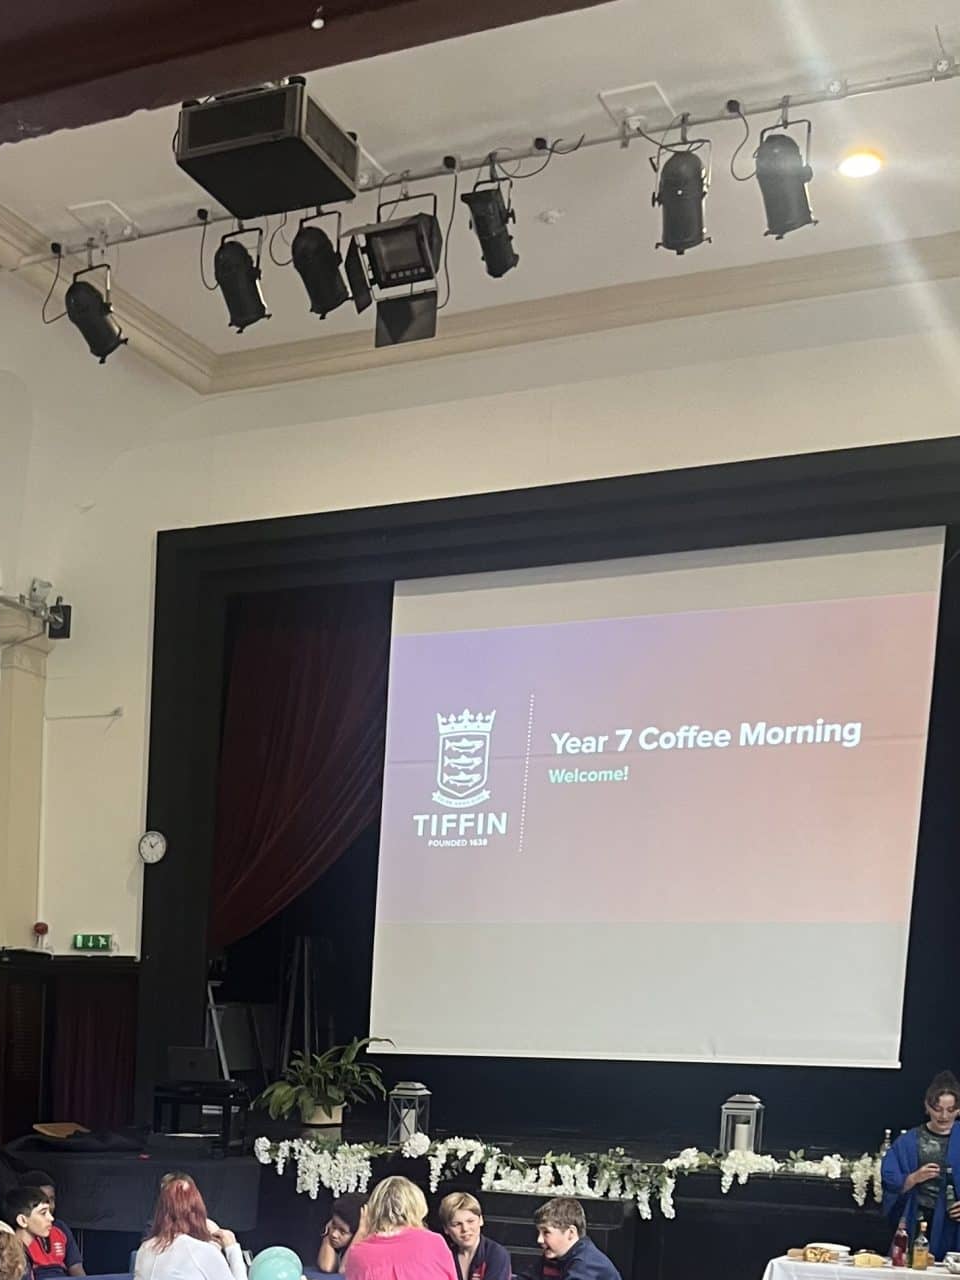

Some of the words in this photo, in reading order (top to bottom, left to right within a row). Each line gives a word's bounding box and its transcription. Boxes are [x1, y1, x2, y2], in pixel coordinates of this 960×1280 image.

[551, 731, 609, 755] Year
[615, 728, 633, 752] 7
[639, 726, 732, 751] Coffee
[739, 718, 863, 747] Morning
[548, 766, 629, 783] Welcome!
[413, 811, 508, 836] TIFFIN
[428, 839, 468, 847] FOUNDED
